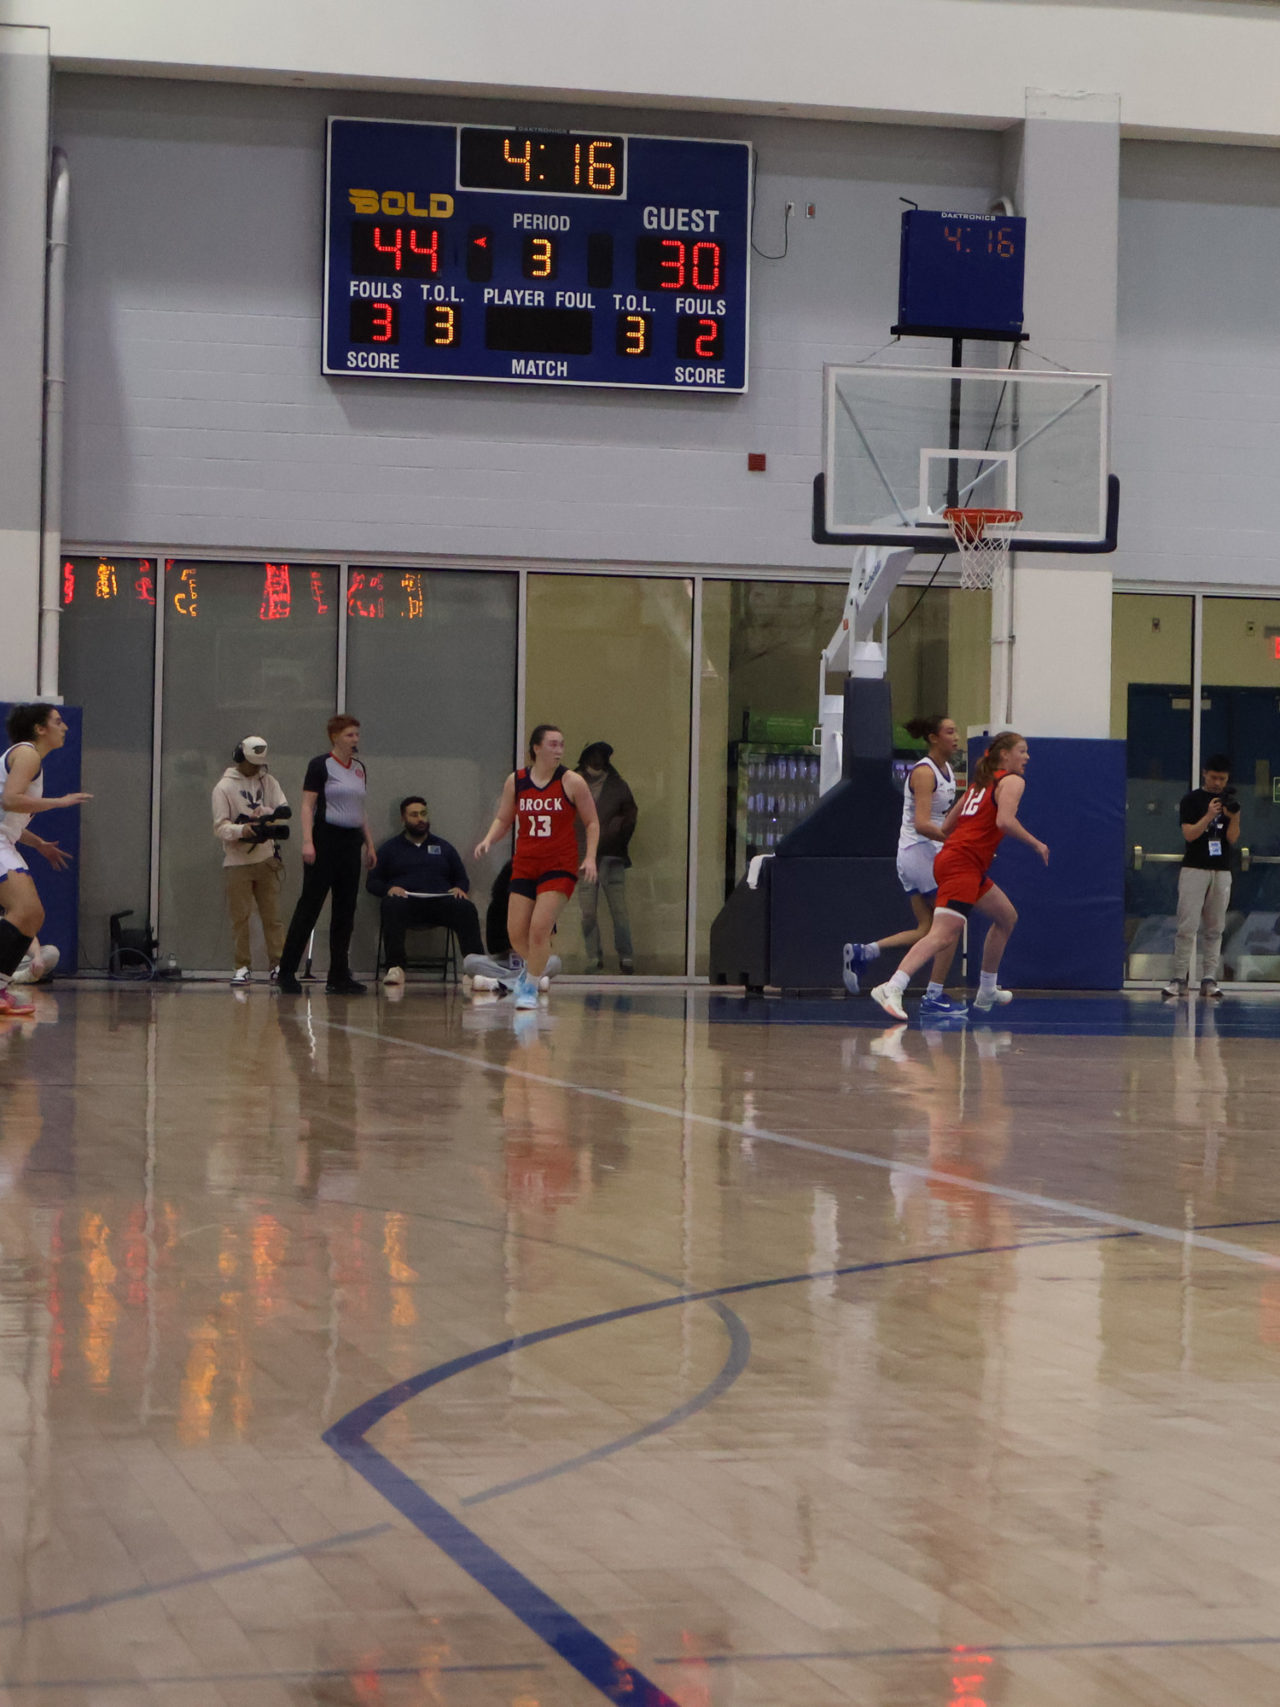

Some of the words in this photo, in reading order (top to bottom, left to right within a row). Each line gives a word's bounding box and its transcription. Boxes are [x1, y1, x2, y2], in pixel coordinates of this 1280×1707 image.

[504, 138, 616, 190] 4:16
[348, 188, 454, 219] BOLD
[513, 213, 571, 232] PERIOD
[643, 206, 720, 233] GUEST
[941, 212, 996, 222] DAKTRONICS
[374, 227, 438, 273] 44
[532, 238, 552, 277] 3
[661, 240, 720, 290] 30
[350, 282, 402, 300] FOULS
[420, 285, 465, 303] T.O.L.
[484, 289, 545, 307] PLAYER
[555, 291, 596, 309] FOUL
[613, 295, 656, 313] T.O.L.
[676, 298, 726, 316] FOULS
[372, 303, 392, 341] 3
[434, 306, 454, 345] 3
[626, 315, 645, 355] 3
[695, 319, 718, 357] 2
[347, 351, 400, 370] SCORE
[511, 359, 568, 378] MATCH
[675, 366, 726, 384] SCORE
[520, 798, 563, 811] BROCK
[961, 787, 986, 816] 12
[528, 815, 551, 837] 13
